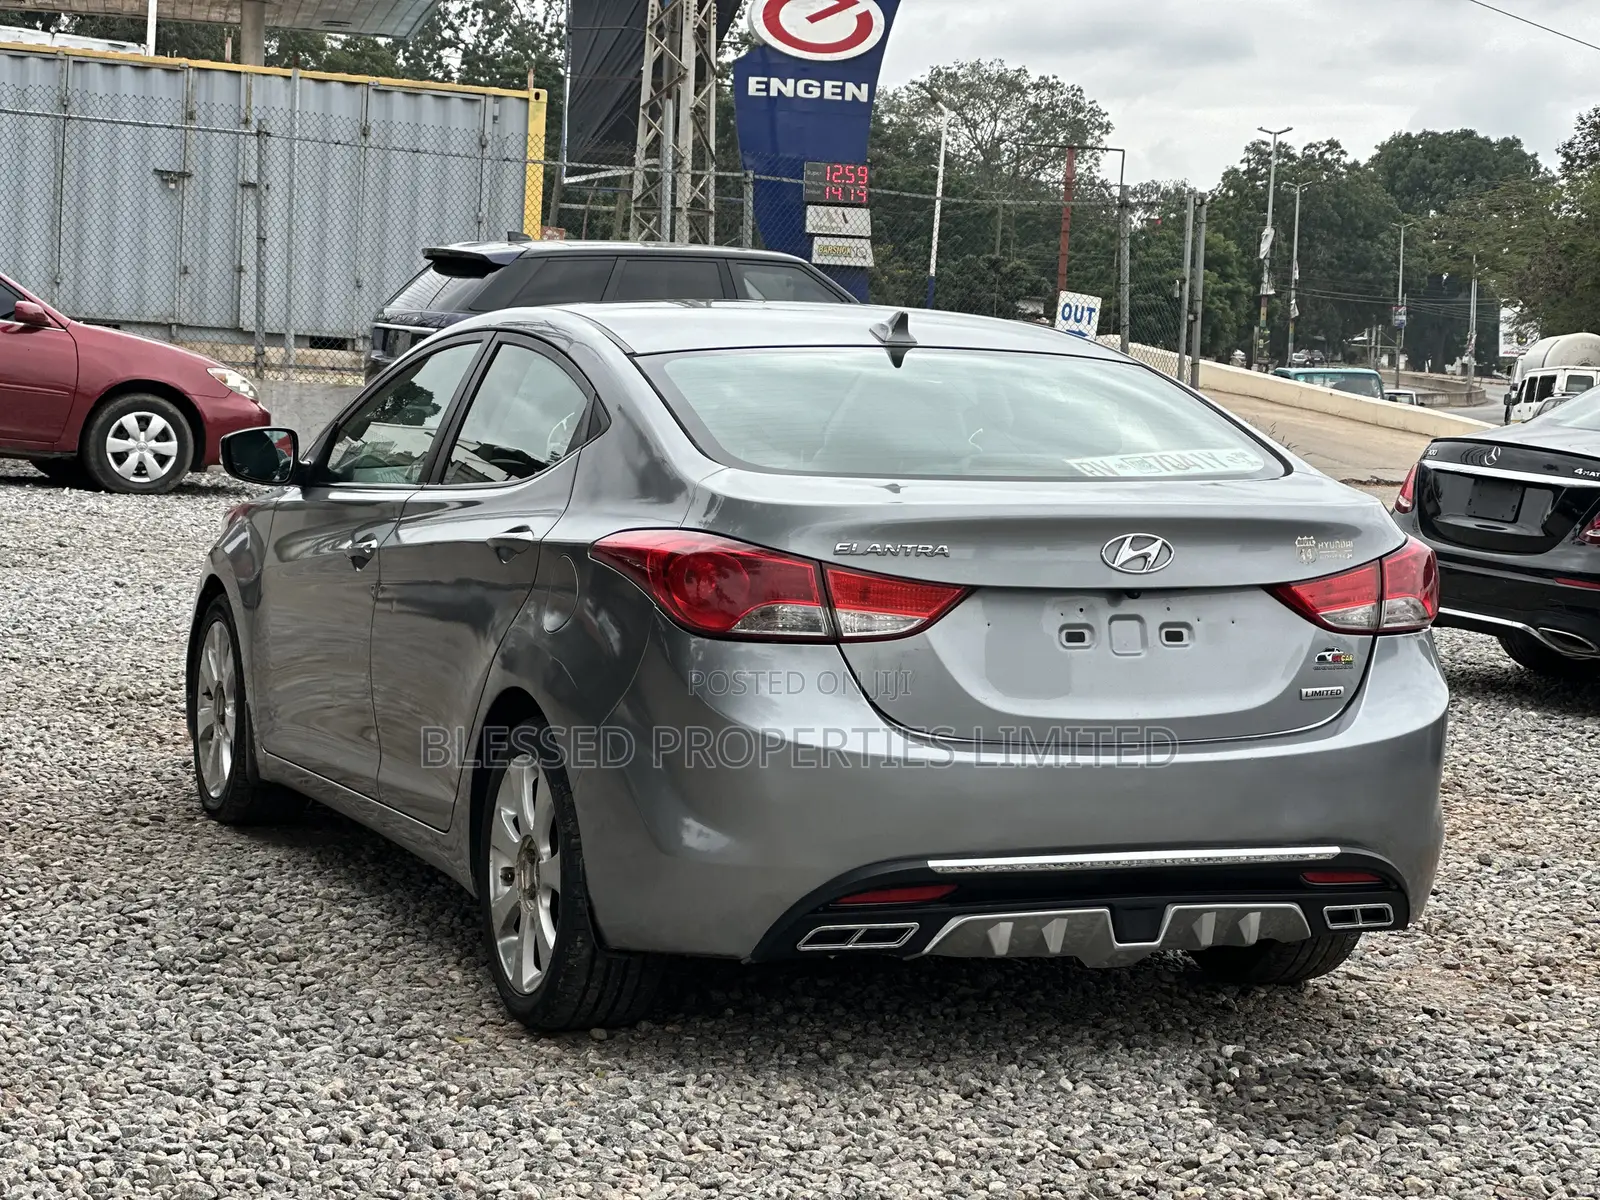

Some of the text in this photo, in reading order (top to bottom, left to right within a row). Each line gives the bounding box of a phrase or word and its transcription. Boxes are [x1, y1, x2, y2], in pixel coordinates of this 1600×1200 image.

[748, 76, 869, 102] ENGEN
[826, 164, 868, 184] 12.59
[1061, 302, 1096, 325] OUT
[833, 542, 950, 557] ELANTRA
[1304, 689, 1342, 698] LIMITED
